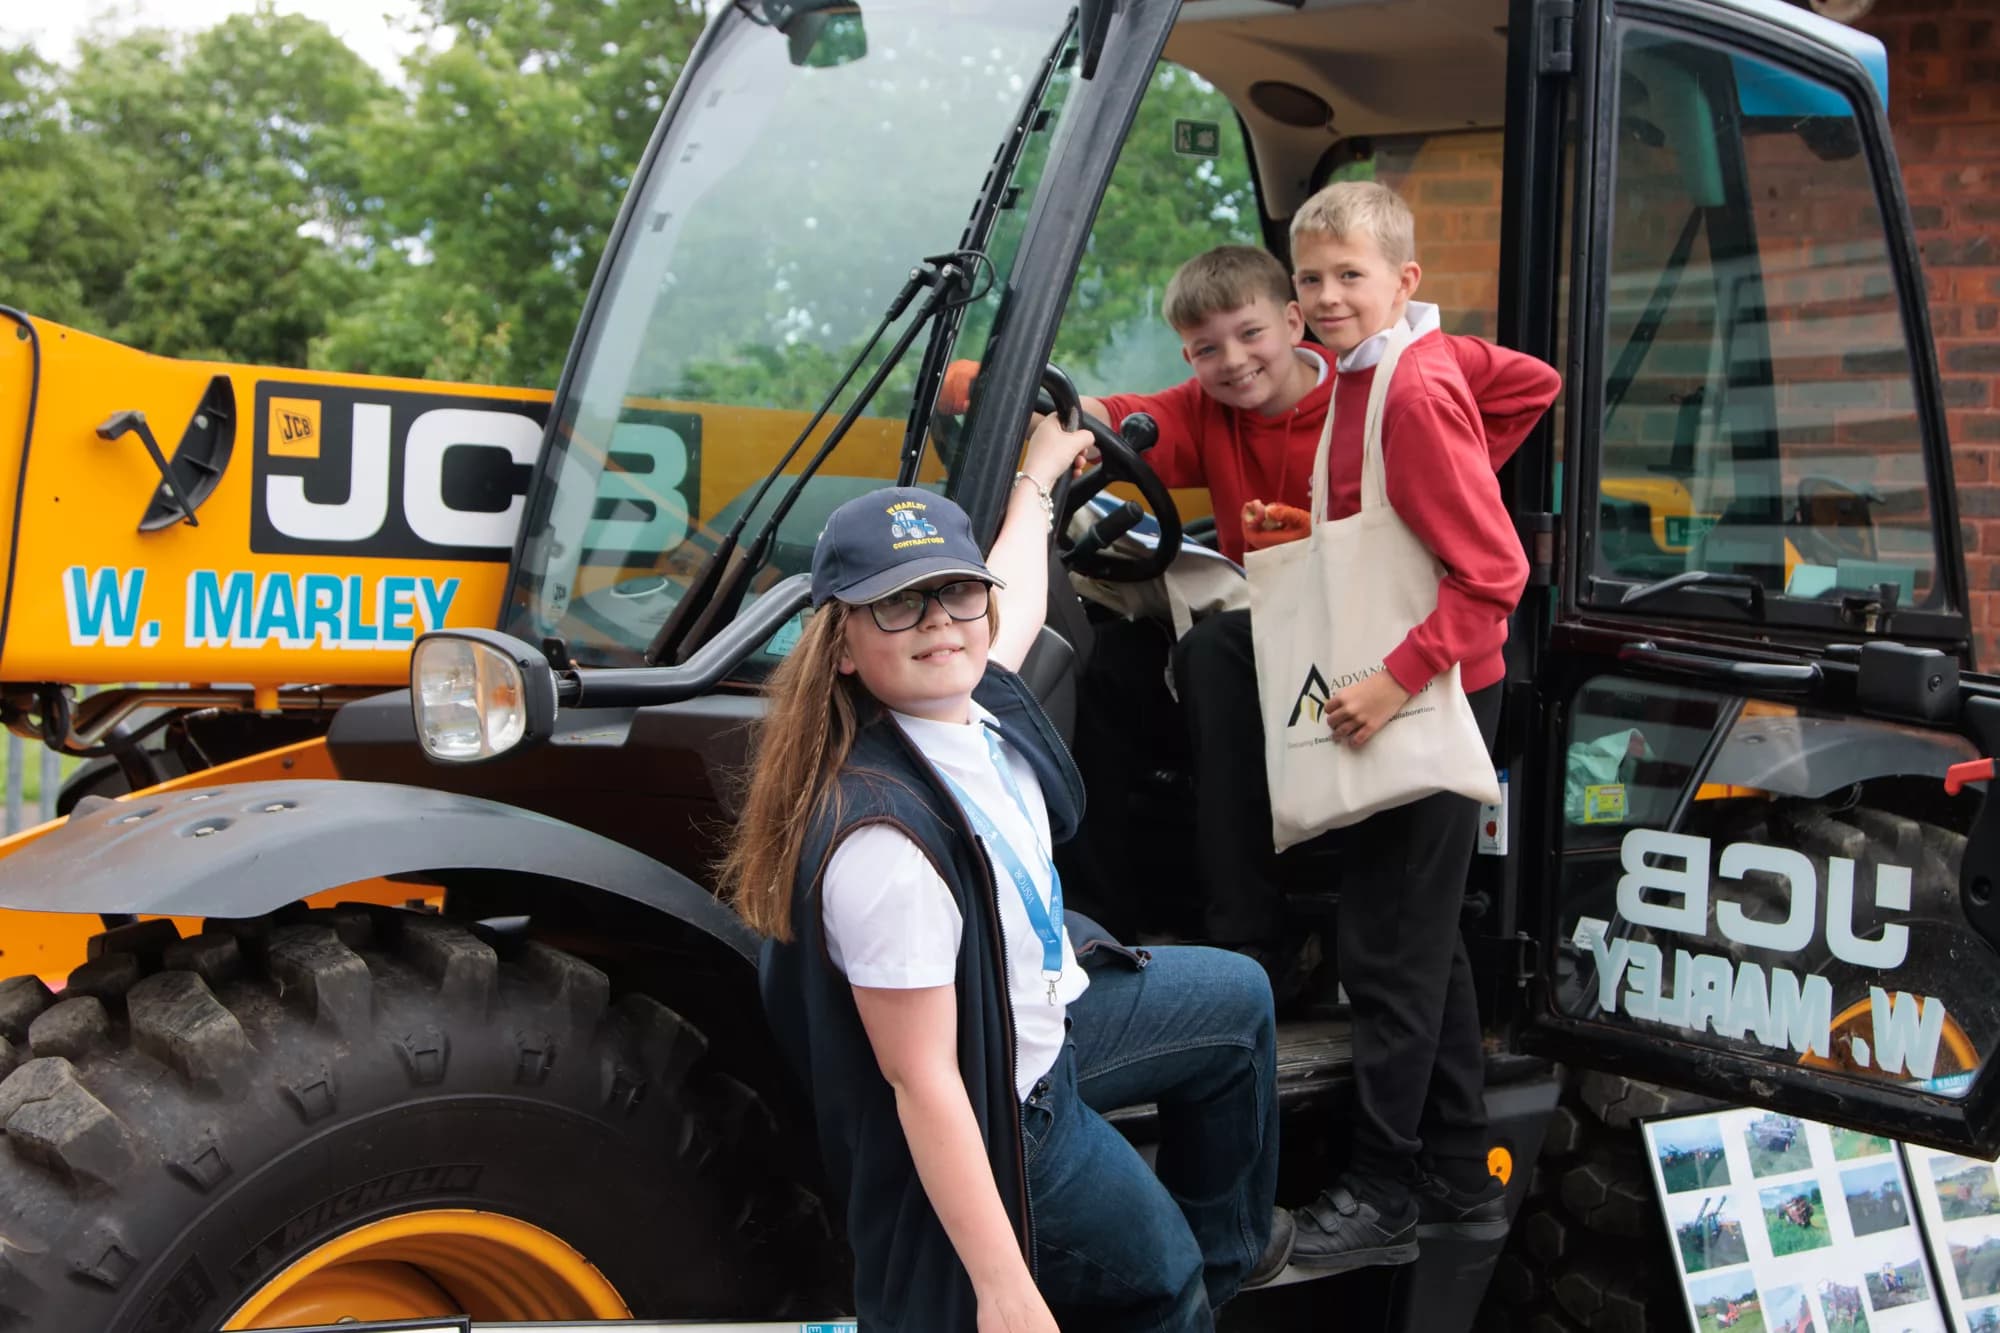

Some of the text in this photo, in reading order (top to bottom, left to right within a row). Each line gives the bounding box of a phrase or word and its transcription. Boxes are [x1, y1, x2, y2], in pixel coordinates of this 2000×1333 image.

[283, 413, 311, 440] JCB
[266, 402, 690, 552] JCB
[62, 566, 461, 650] W. MARLEY
